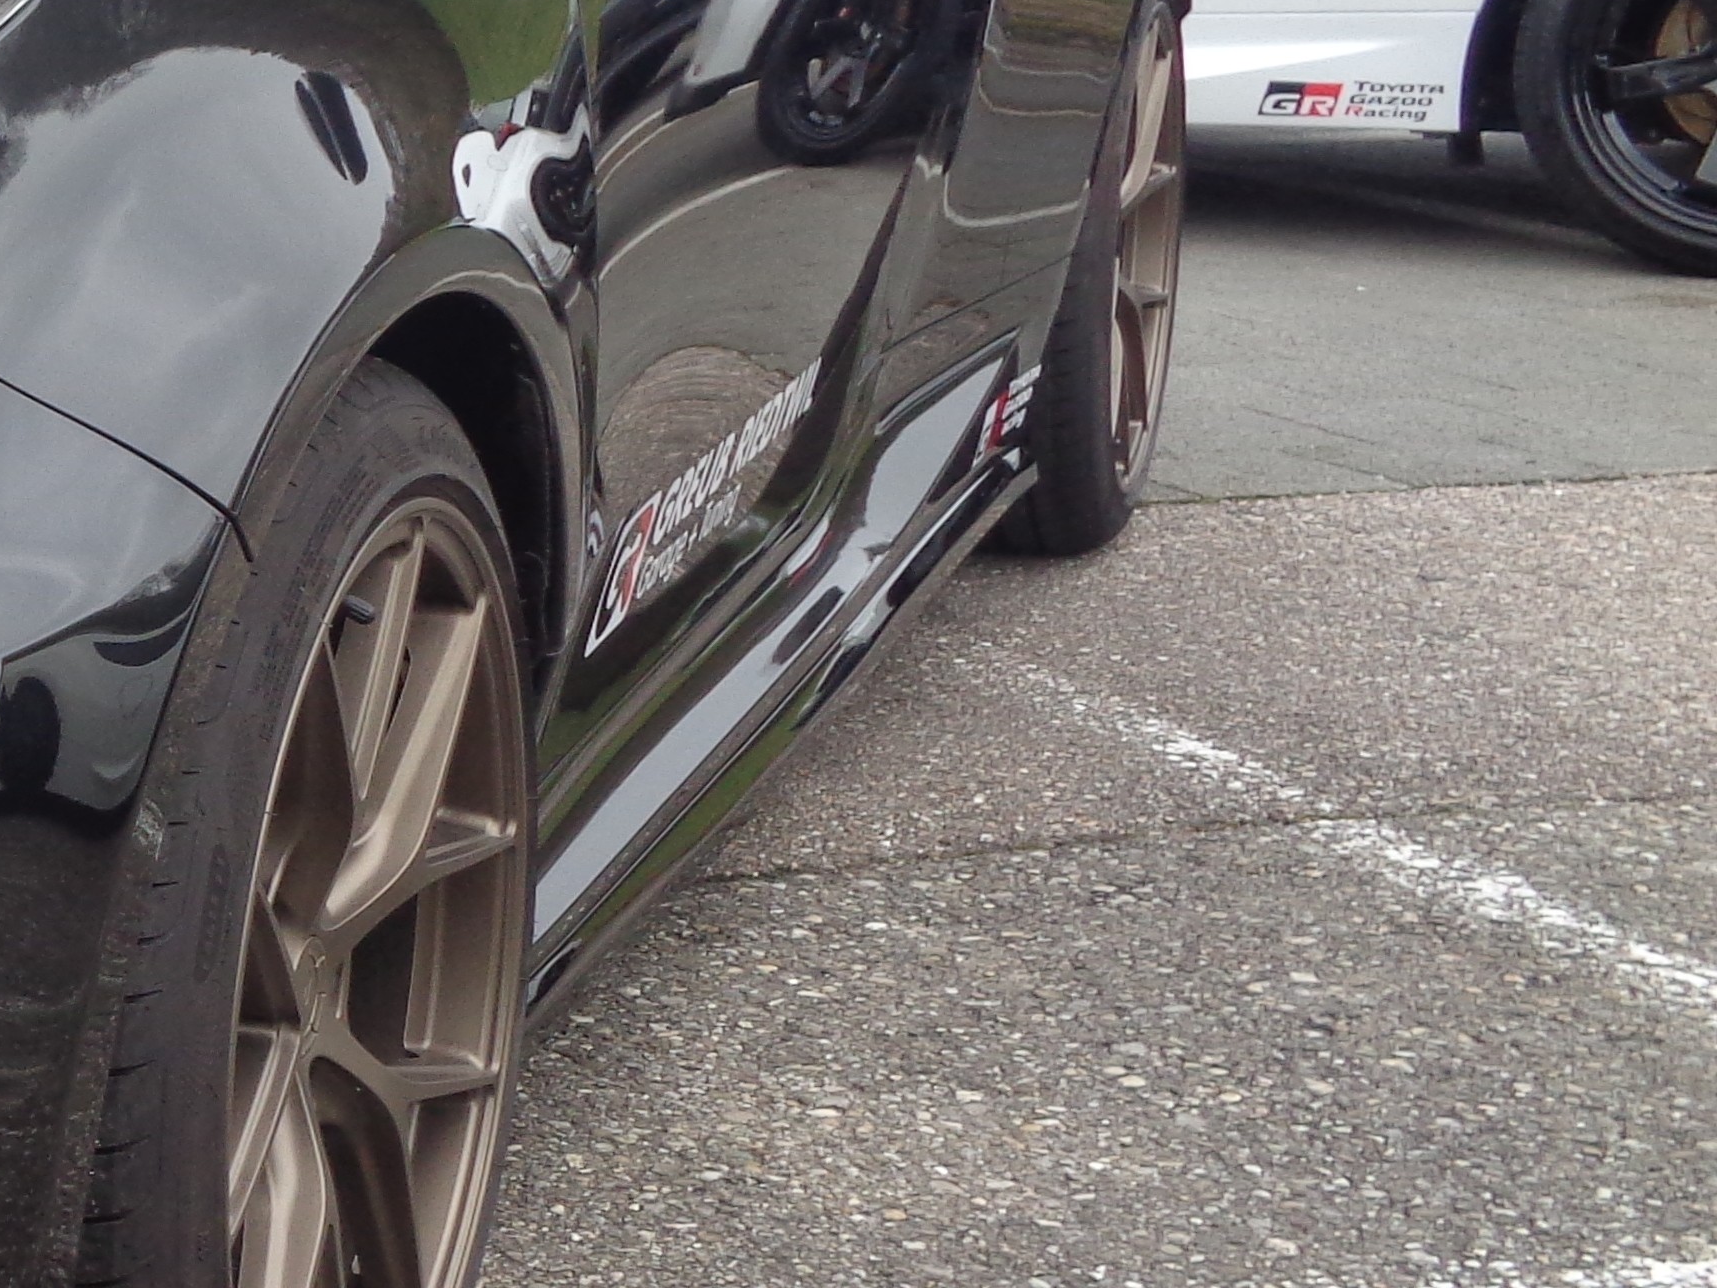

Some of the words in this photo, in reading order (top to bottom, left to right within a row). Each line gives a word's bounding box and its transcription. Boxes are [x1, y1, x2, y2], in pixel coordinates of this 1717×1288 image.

[1259, 90, 1338, 117] GR
[1349, 93, 1433, 107] GAZOO
[1344, 105, 1427, 122] Racing
[653, 433, 736, 546] GREUB
